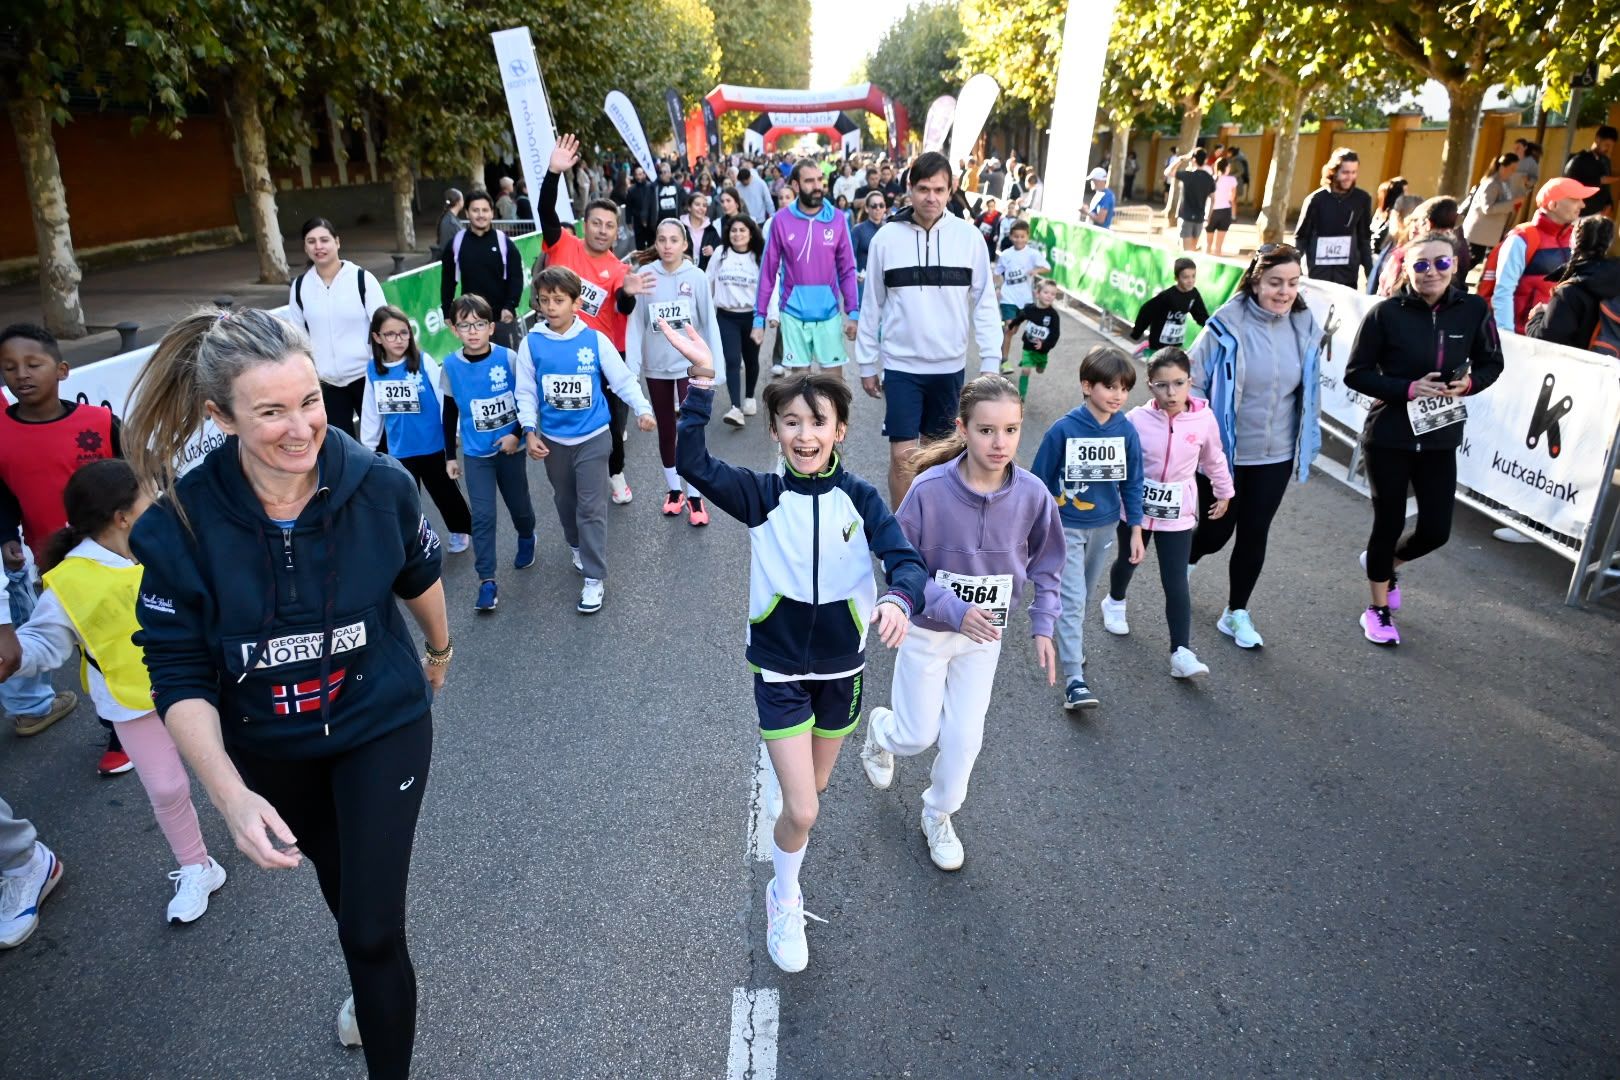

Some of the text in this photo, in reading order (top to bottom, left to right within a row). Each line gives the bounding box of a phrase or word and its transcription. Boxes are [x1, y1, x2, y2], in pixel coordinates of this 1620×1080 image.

[774, 111, 834, 124] kutxabank
[580, 285, 598, 301] 378
[658, 306, 681, 318] 3272
[385, 386, 412, 398] 3275
[553, 381, 582, 394] 3279
[481, 400, 507, 417] 3271
[1078, 445, 1116, 461] 3600
[1492, 450, 1580, 505] kutxabank
[1142, 485, 1173, 503] 3574
[950, 582, 998, 604] 3564
